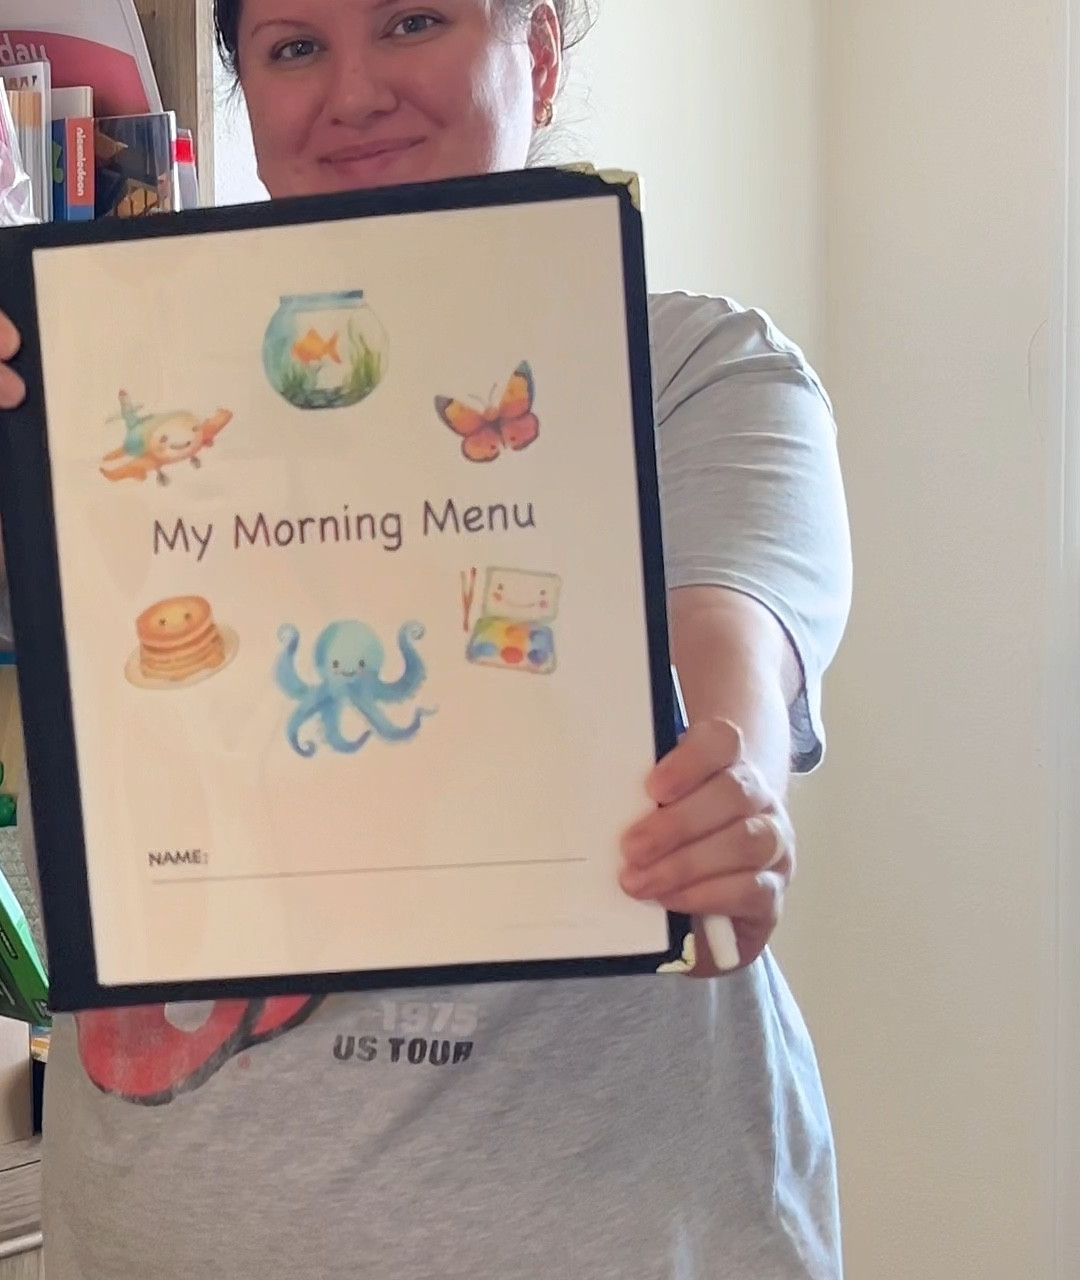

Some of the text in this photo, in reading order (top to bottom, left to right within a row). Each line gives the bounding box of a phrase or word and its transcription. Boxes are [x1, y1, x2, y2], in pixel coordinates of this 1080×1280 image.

[76, 127, 87, 197] nickelodeon
[153, 498, 536, 562] My Morning Menu
[148, 849, 209, 868] NAME:
[381, 1001, 479, 1035] 1975
[332, 1034, 379, 1062] US
